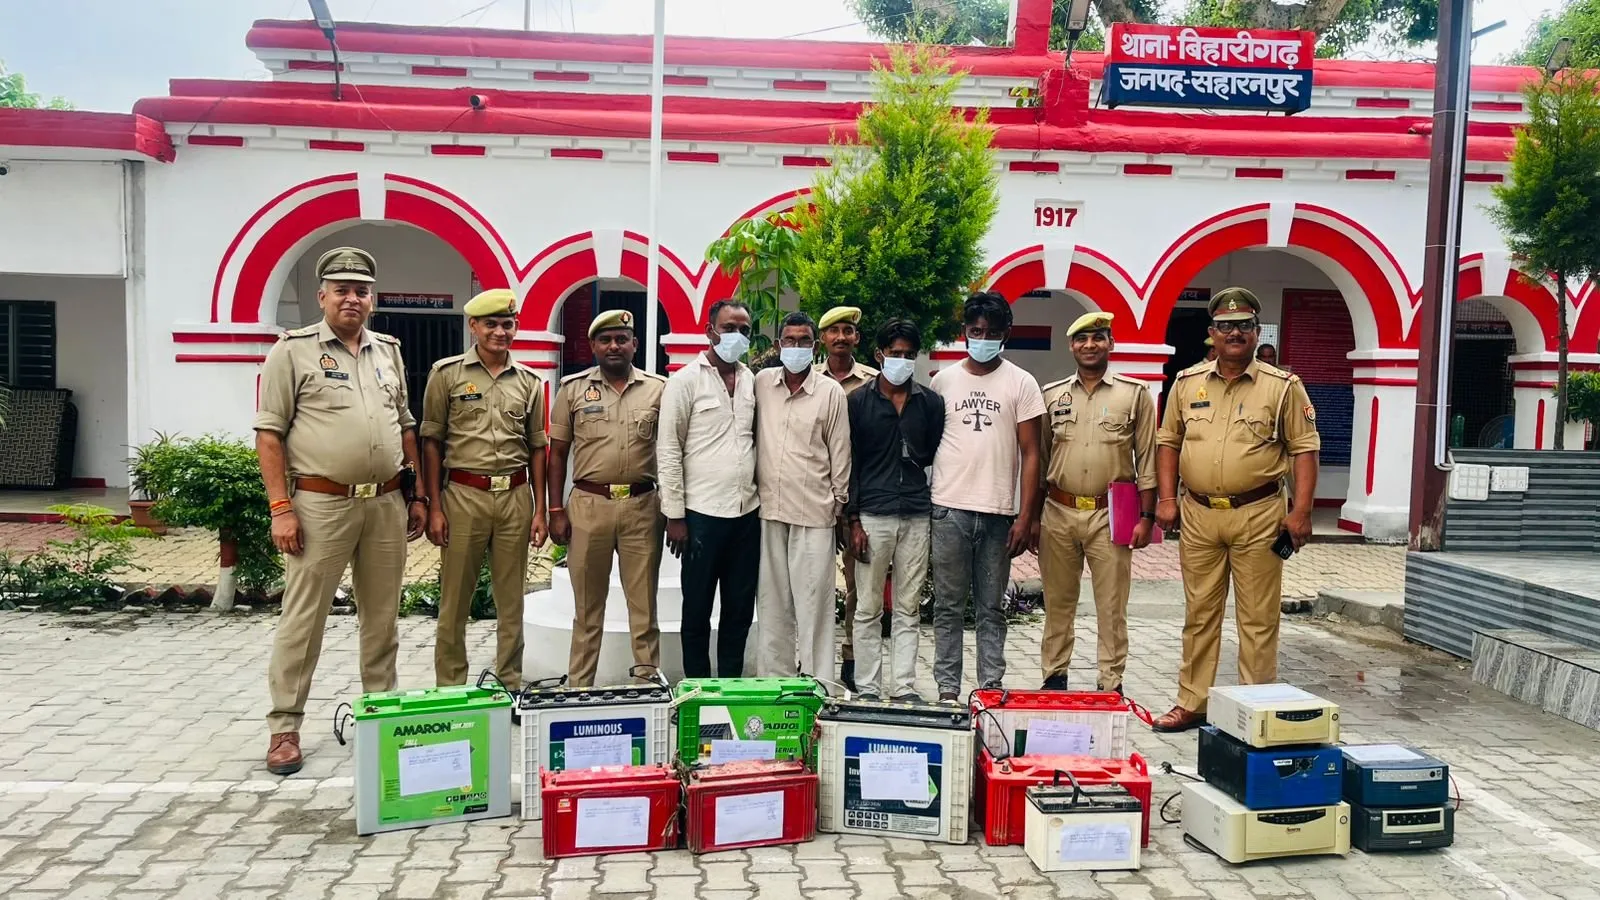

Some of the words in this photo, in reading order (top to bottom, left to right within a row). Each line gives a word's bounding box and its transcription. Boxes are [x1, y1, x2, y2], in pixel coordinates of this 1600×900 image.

[1118, 67, 1303, 105] जनपद-सहारनपुर
[1034, 206, 1078, 228] 1917
[954, 398, 1001, 413] LAWYER
[393, 721, 451, 737] AMARON
[573, 723, 623, 736] LUMINOUS
